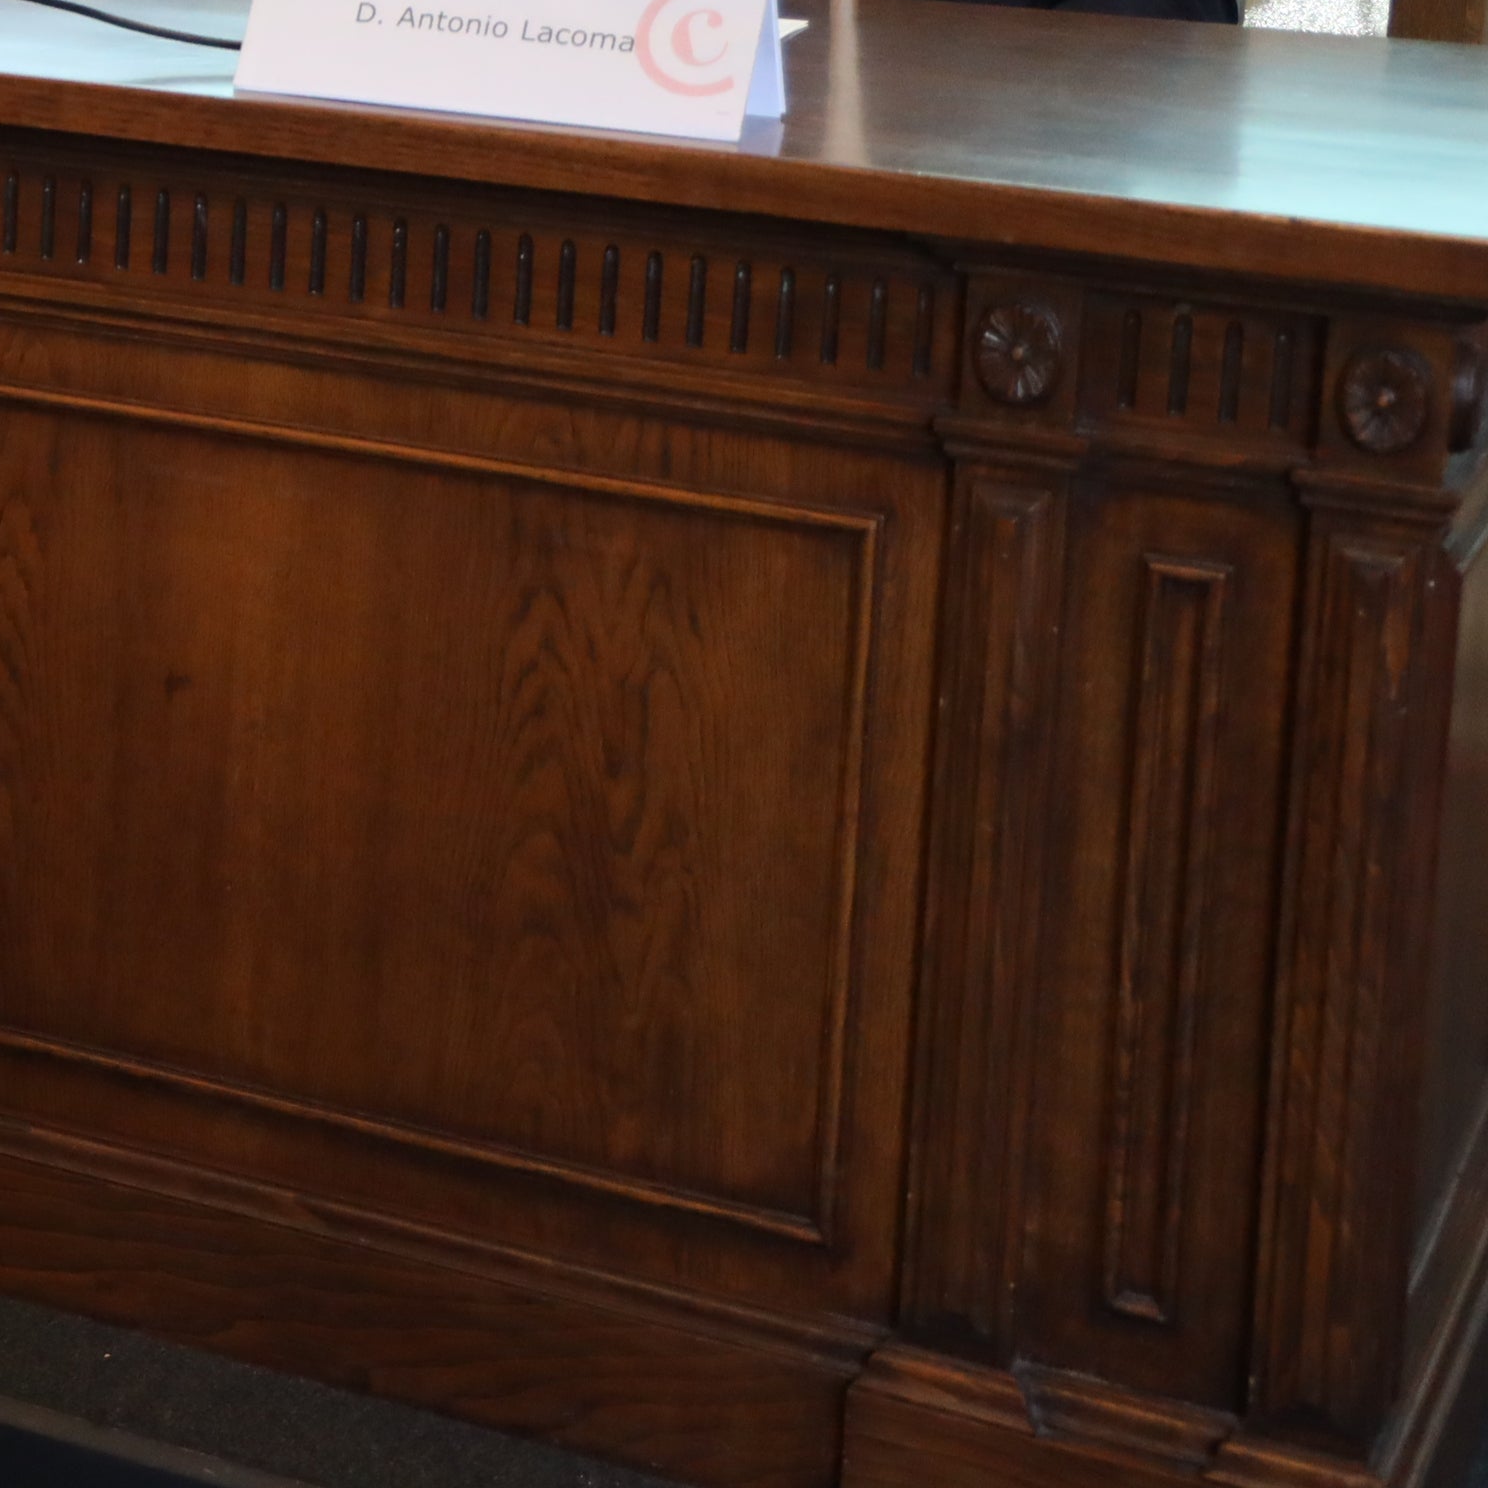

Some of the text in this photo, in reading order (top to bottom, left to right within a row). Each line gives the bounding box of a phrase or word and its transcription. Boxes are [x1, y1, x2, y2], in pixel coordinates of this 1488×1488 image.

[355, 1, 636, 53] D. Antonio Lacoma
